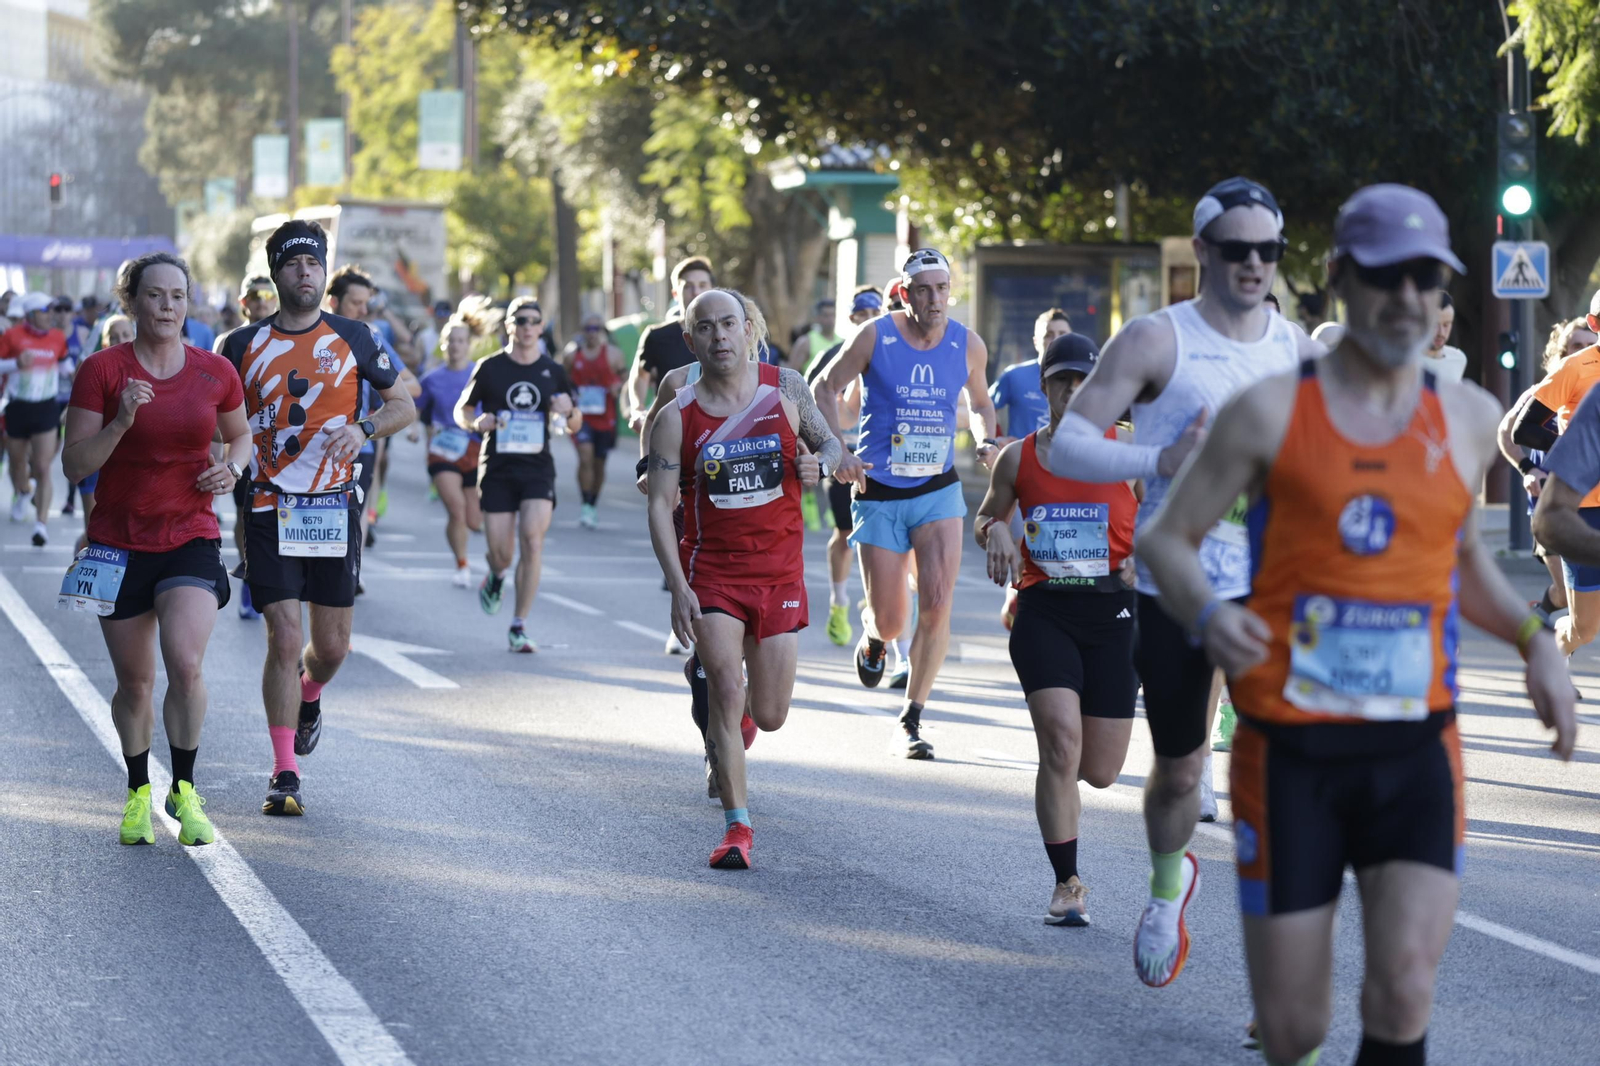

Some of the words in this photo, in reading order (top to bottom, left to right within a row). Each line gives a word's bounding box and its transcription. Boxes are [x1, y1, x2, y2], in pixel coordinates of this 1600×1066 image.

[282, 237, 319, 252] TERREX
[930, 388, 946, 396] MG
[896, 408, 920, 416] TEAM
[268, 404, 278, 468] DUCHENNE
[914, 426, 946, 434] ZURICH
[904, 450, 938, 462] HERVÉ
[732, 462, 755, 474] 3783
[728, 475, 764, 492] FALA
[1052, 508, 1098, 518] ZURICH
[302, 516, 322, 524] 6579
[285, 528, 342, 540] MINGUEZ
[1054, 529, 1077, 539] 7562
[1061, 547, 1108, 560] SÁNCHEZ
[79, 567, 98, 578] 7374
[77, 580, 93, 596] YN
